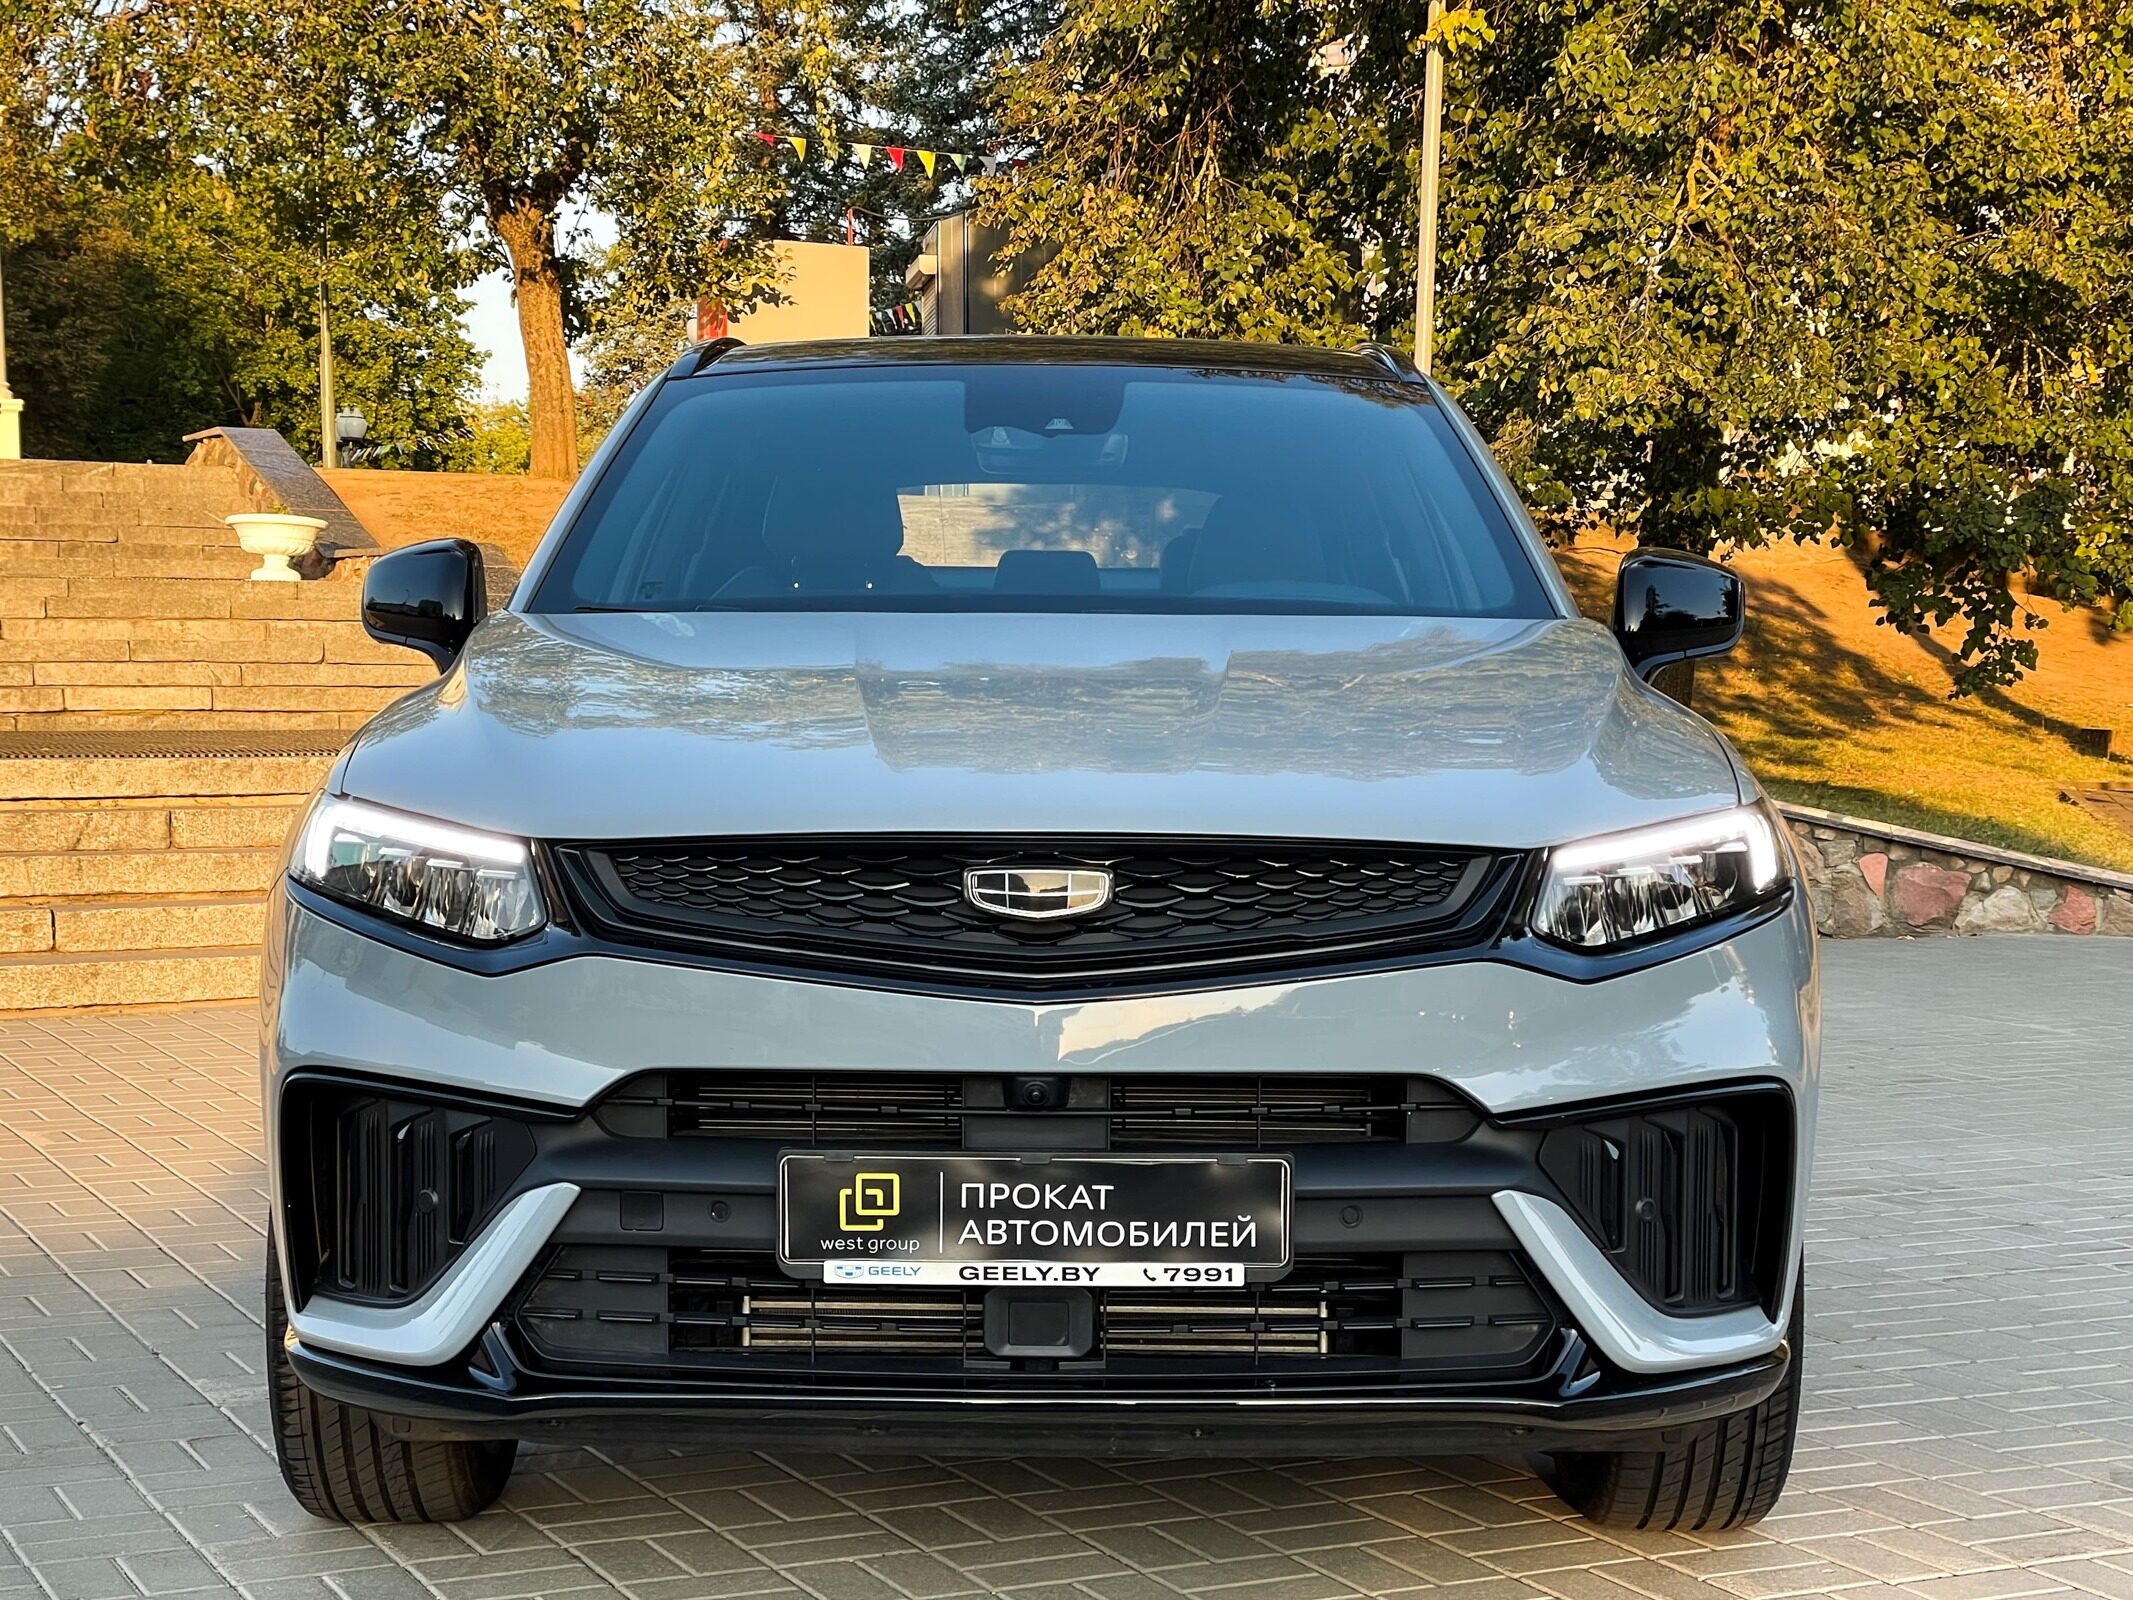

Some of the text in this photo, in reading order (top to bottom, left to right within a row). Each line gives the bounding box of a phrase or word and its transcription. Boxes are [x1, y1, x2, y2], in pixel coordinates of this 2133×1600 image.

[960, 1183, 1115, 1210] ПРОКАТ
[958, 1215, 1257, 1248] АВТОМОБИЛЕЙ
[820, 1236, 920, 1254] west group
[868, 1266, 922, 1276] GEELY
[958, 1266, 1100, 1282] GEELY.BY
[1164, 1267, 1234, 1282] 7991
